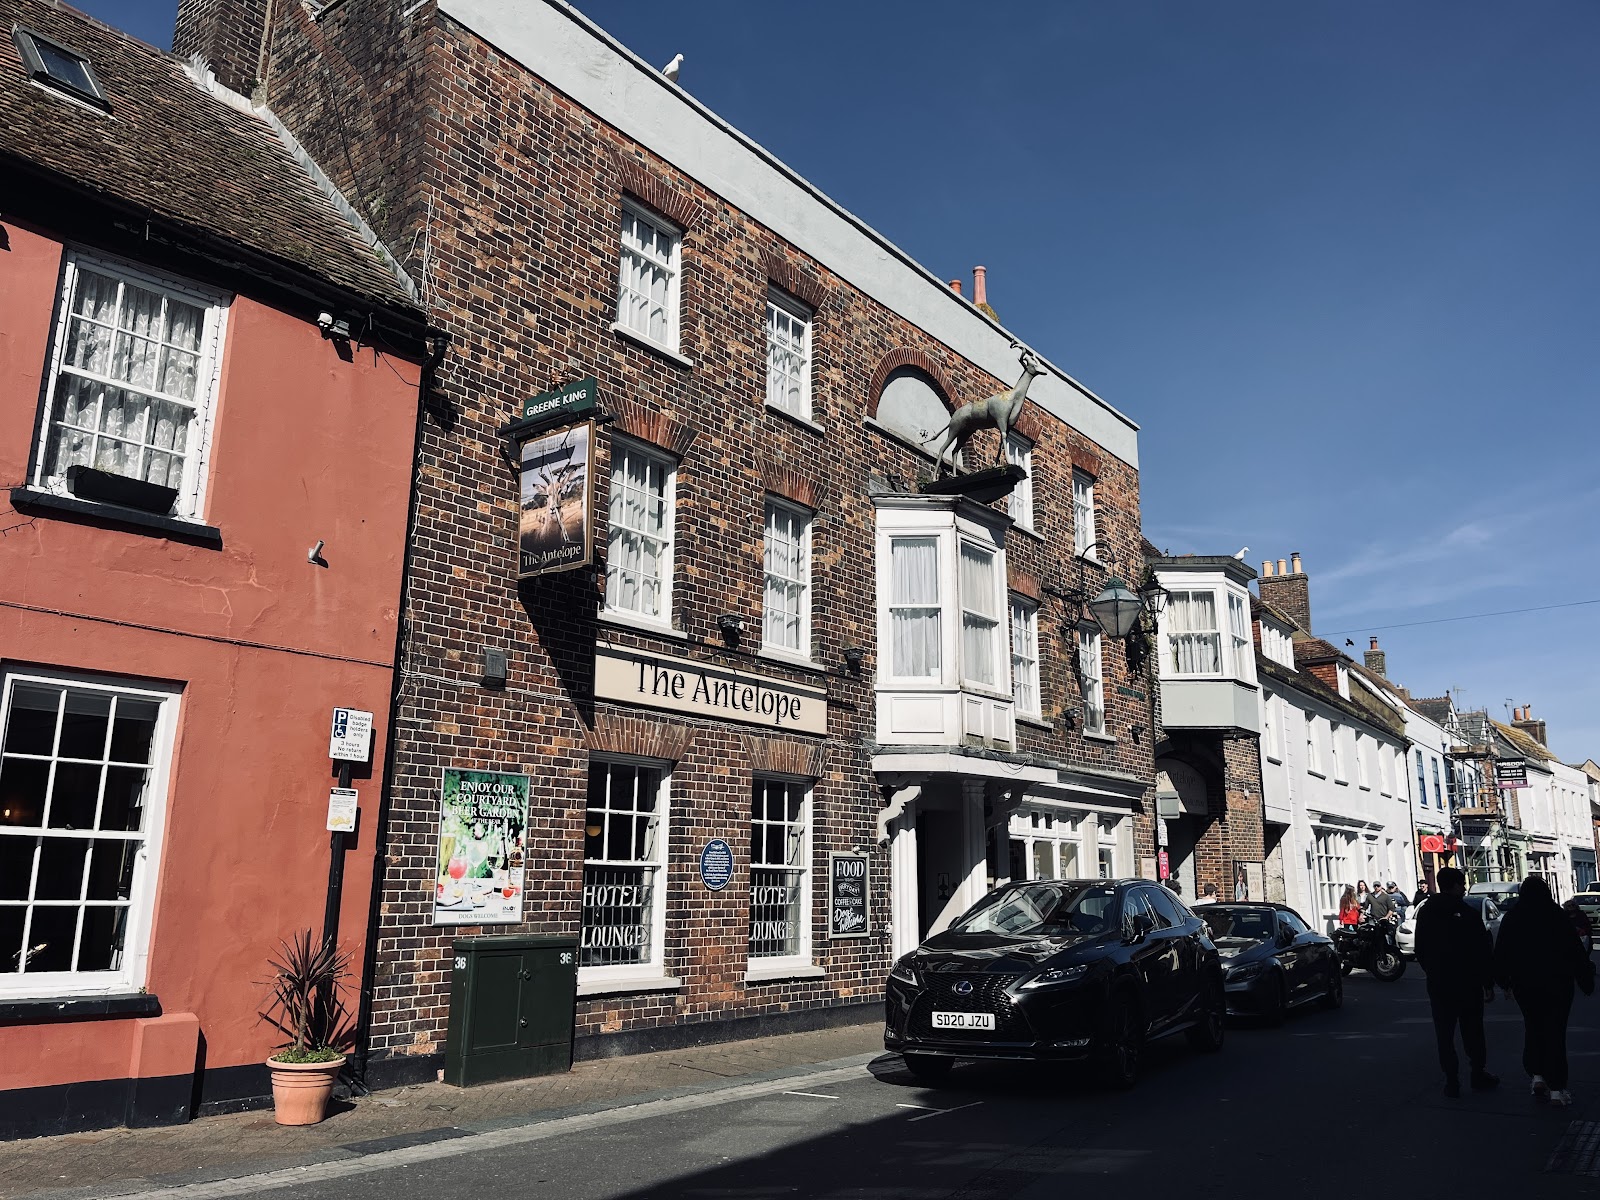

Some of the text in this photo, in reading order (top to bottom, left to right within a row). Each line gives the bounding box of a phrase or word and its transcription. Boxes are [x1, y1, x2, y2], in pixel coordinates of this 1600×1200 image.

[526, 389, 587, 416] GREENE KING
[523, 545, 581, 566] The Antelope
[632, 657, 801, 725] The Antelope
[338, 711, 347, 724] P
[460, 781, 515, 795] ENJOY OUR
[456, 793, 517, 807] COURTYARD
[452, 806, 520, 819] BEER GARDEN
[836, 861, 864, 877] FOOD
[583, 886, 642, 907] HOTEL
[834, 898, 849, 906] COFFEE
[581, 926, 648, 948] LOUNGE
[454, 957, 467, 970] 36
[560, 953, 572, 965] 36
[936, 1014, 989, 1027] SD20 JZU
